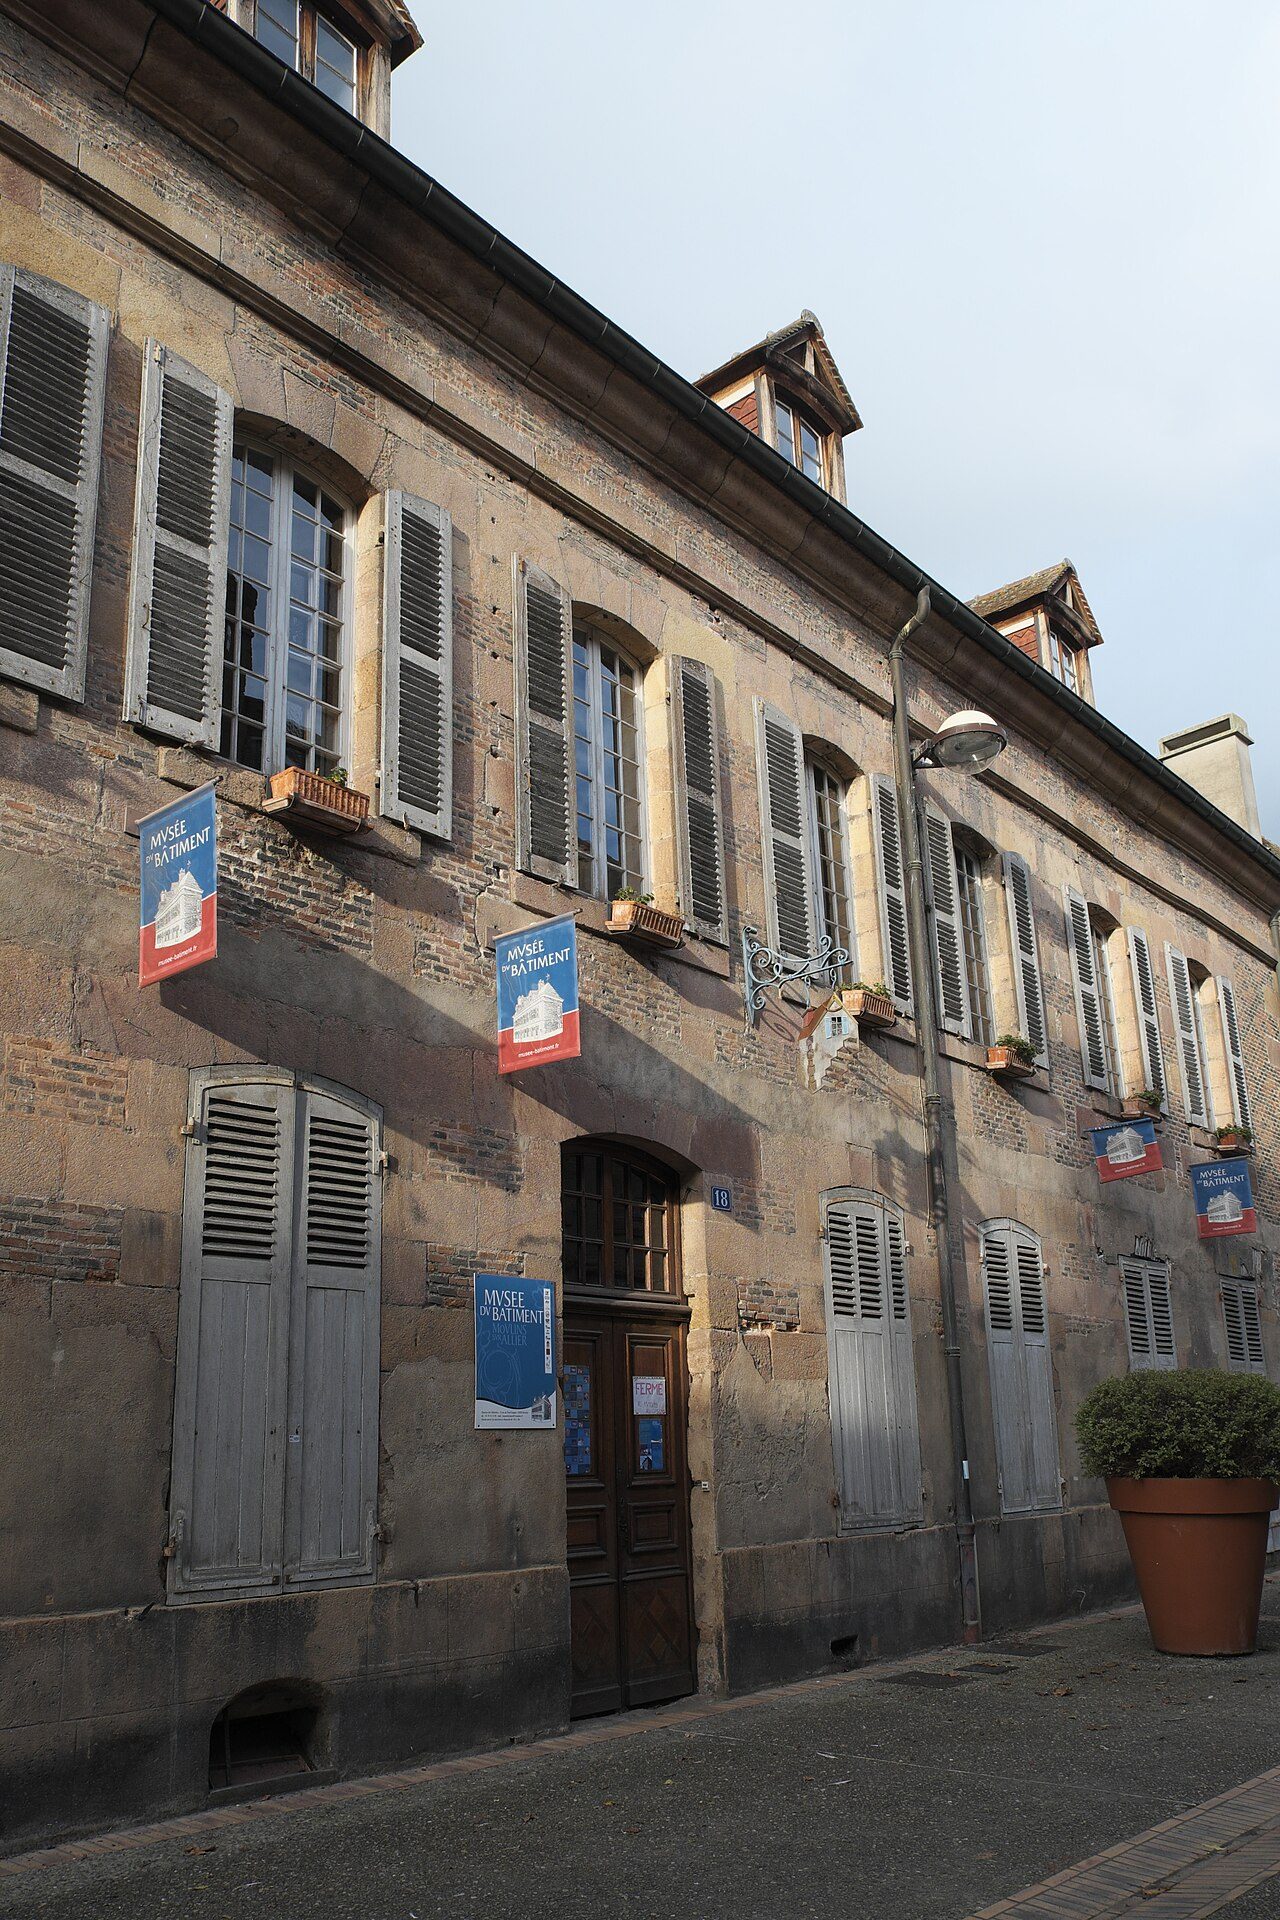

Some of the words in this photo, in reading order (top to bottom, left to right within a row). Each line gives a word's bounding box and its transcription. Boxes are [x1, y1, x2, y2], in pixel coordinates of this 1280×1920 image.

[154, 826, 211, 868] BÂTIMENT
[511, 947, 571, 977] BÂTIMENT
[1203, 1174, 1245, 1187] BÂTIMENT
[714, 1190, 728, 1207] 18
[480, 1305, 491, 1316] DV
[492, 1306, 544, 1324] BATIMENT
[500, 1334, 528, 1346] ALLIER
